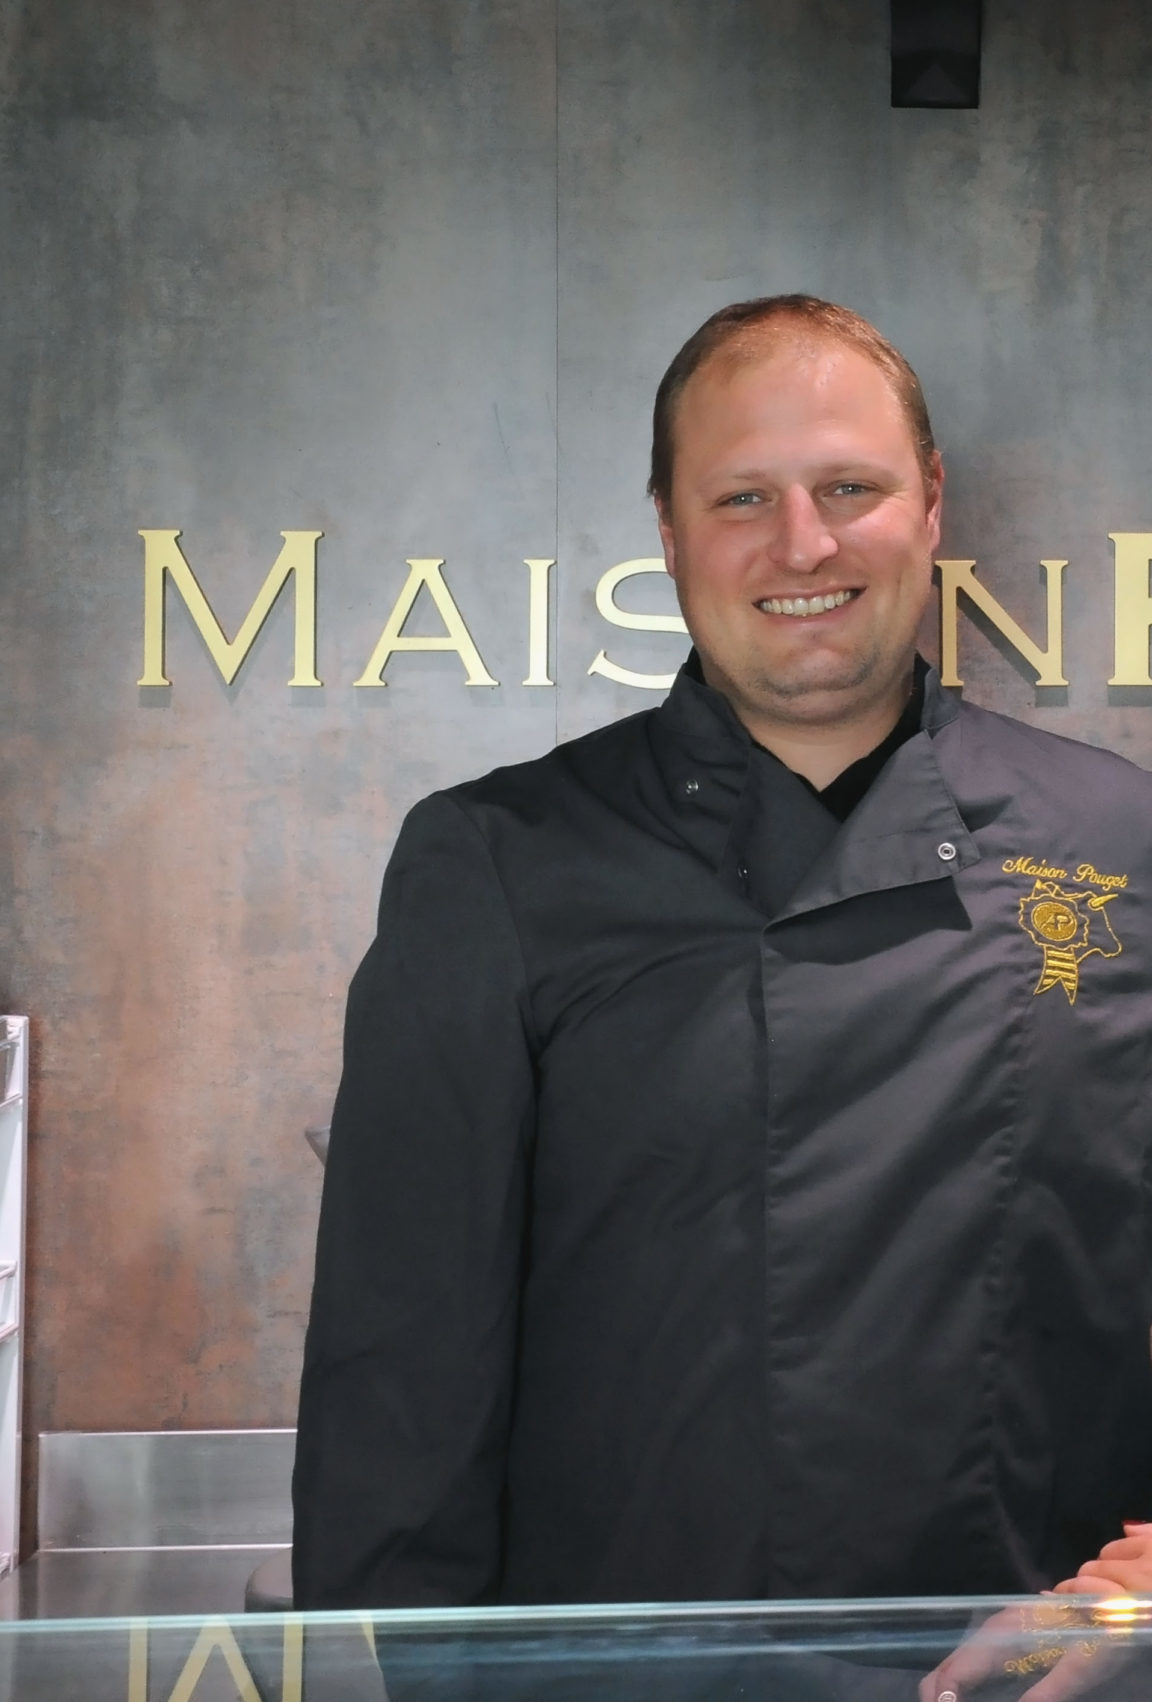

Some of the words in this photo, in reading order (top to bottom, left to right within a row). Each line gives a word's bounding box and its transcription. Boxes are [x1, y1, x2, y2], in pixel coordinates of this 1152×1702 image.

[137, 529, 1070, 689] MAISN
[1002, 856, 1068, 879] Maison
[1072, 863, 1128, 891] Pouget
